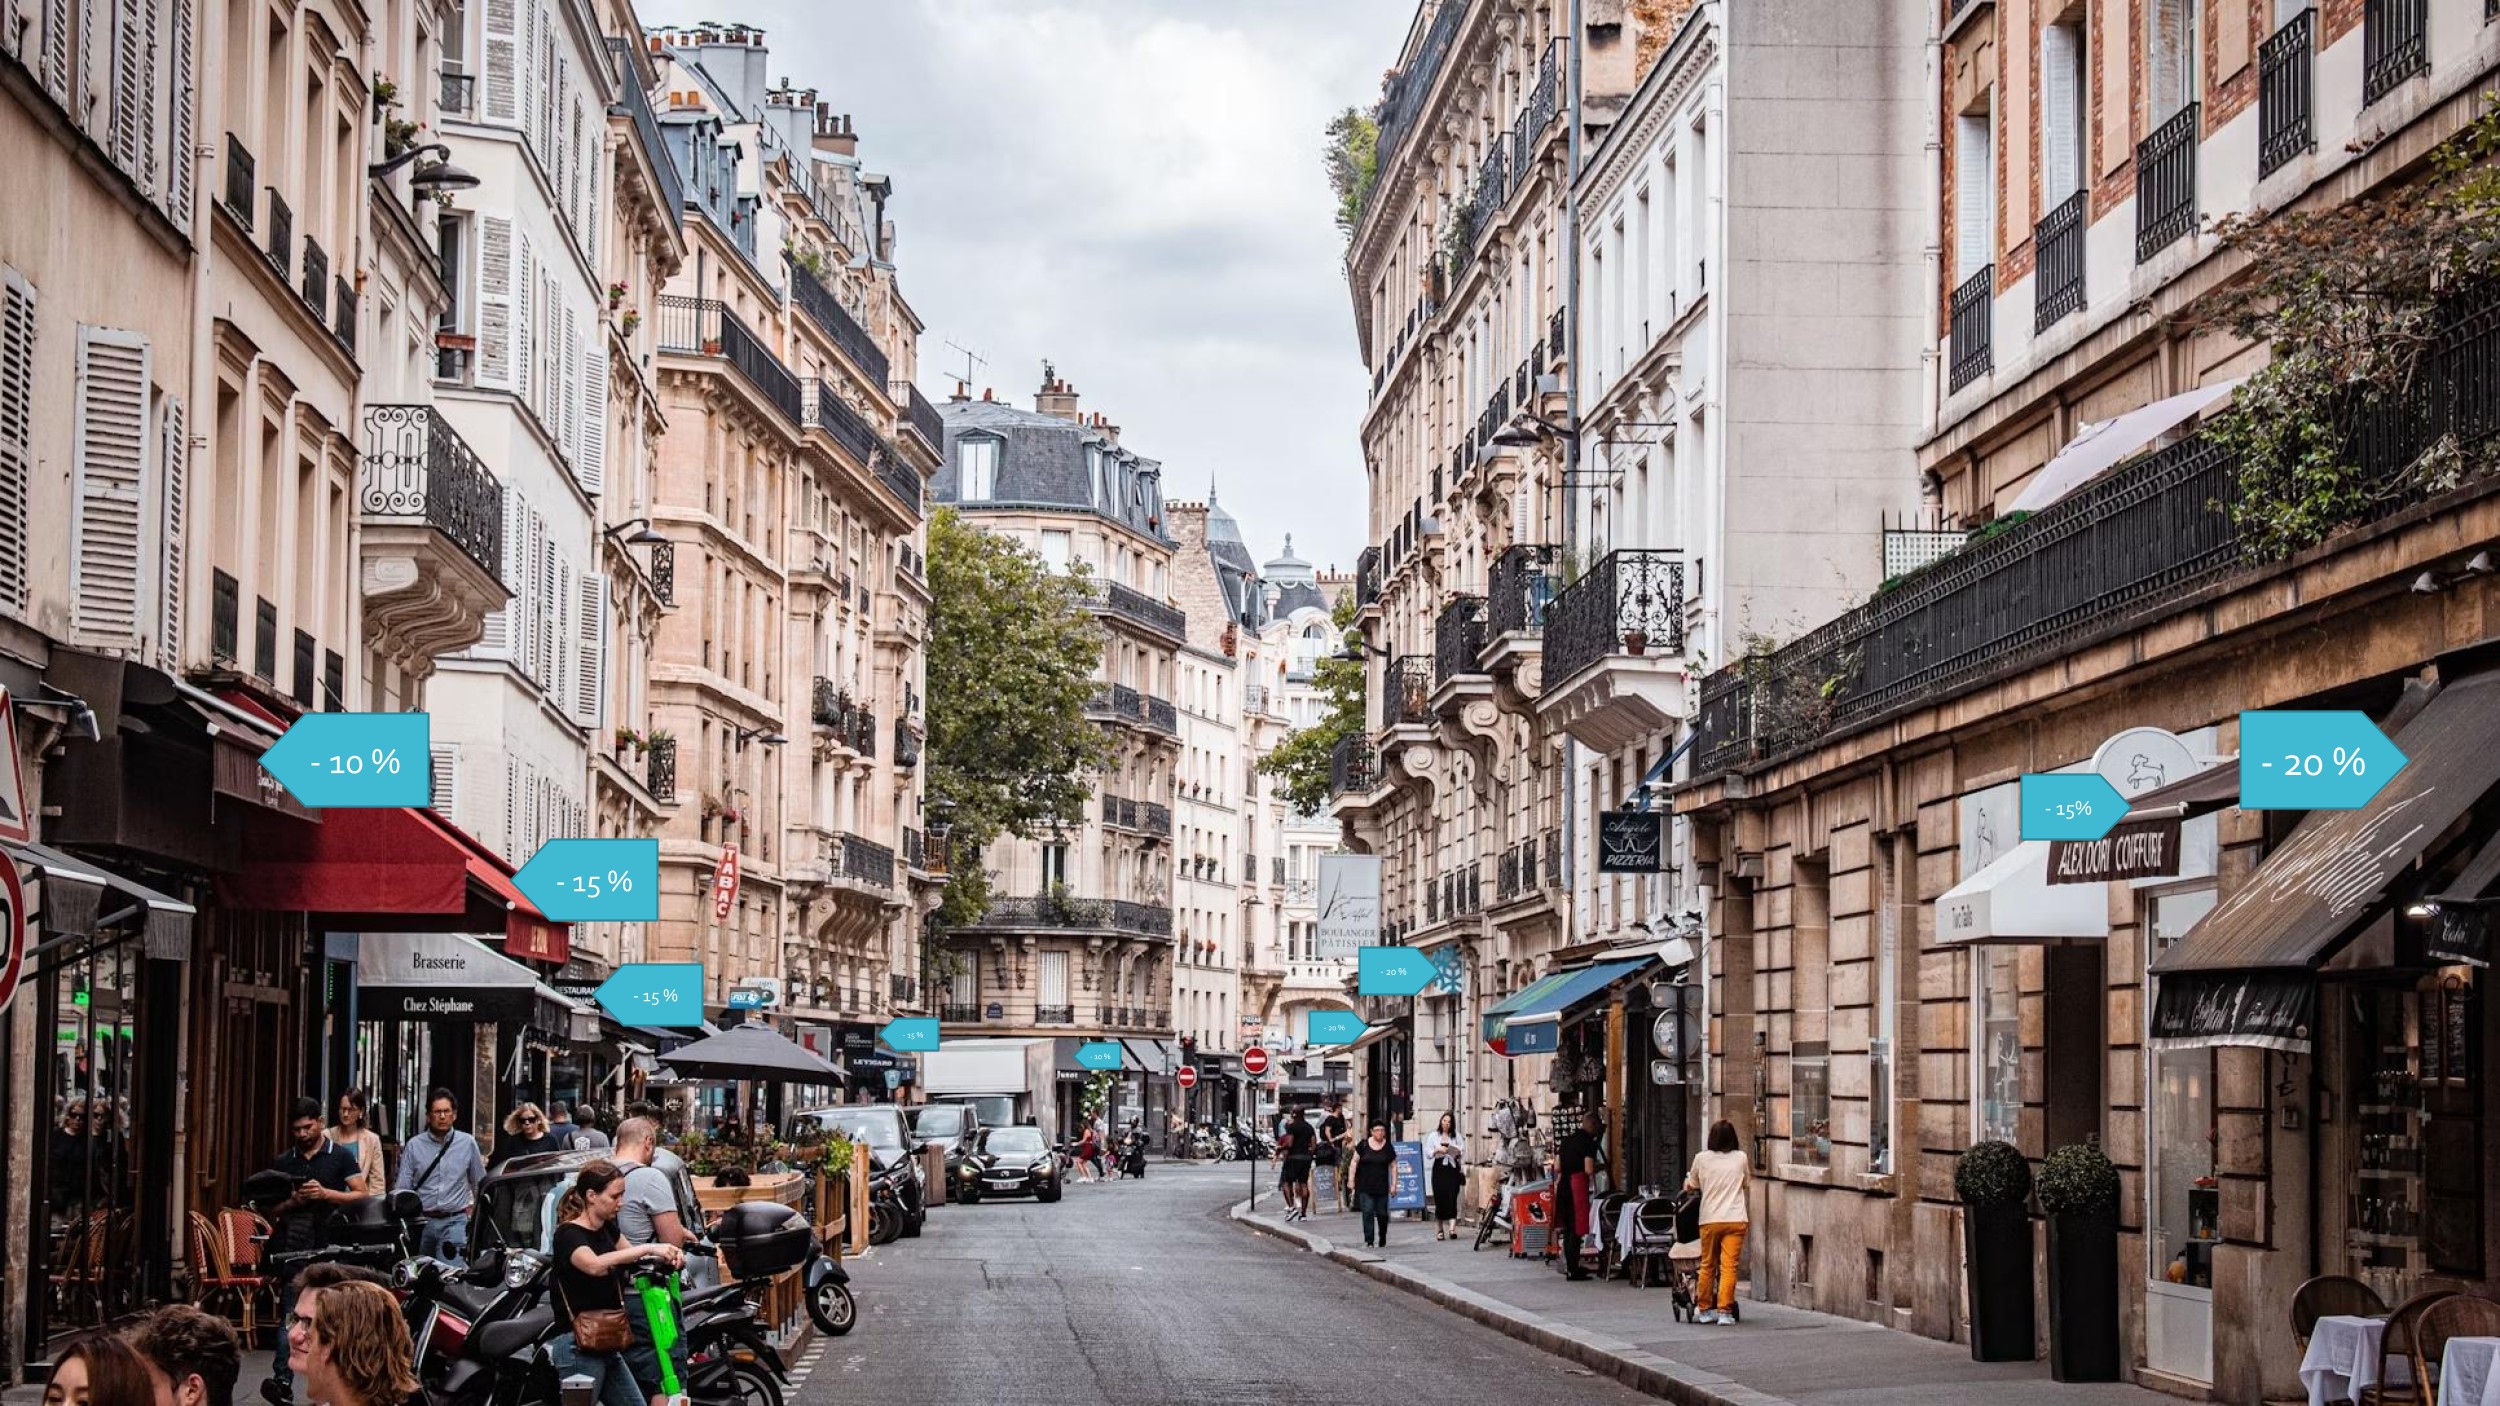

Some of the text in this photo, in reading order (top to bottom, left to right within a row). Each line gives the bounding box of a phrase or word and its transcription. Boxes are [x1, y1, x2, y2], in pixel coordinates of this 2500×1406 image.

[1605, 854, 1656, 866] PIZZERIA
[2057, 839, 2085, 876] ALEX
[2114, 832, 2166, 872] COIFFURE
[717, 849, 736, 915] TABAC
[1320, 929, 1376, 937] BOULANGER
[413, 952, 466, 970] Brasserie
[403, 996, 474, 1015] Chez Stéphane
